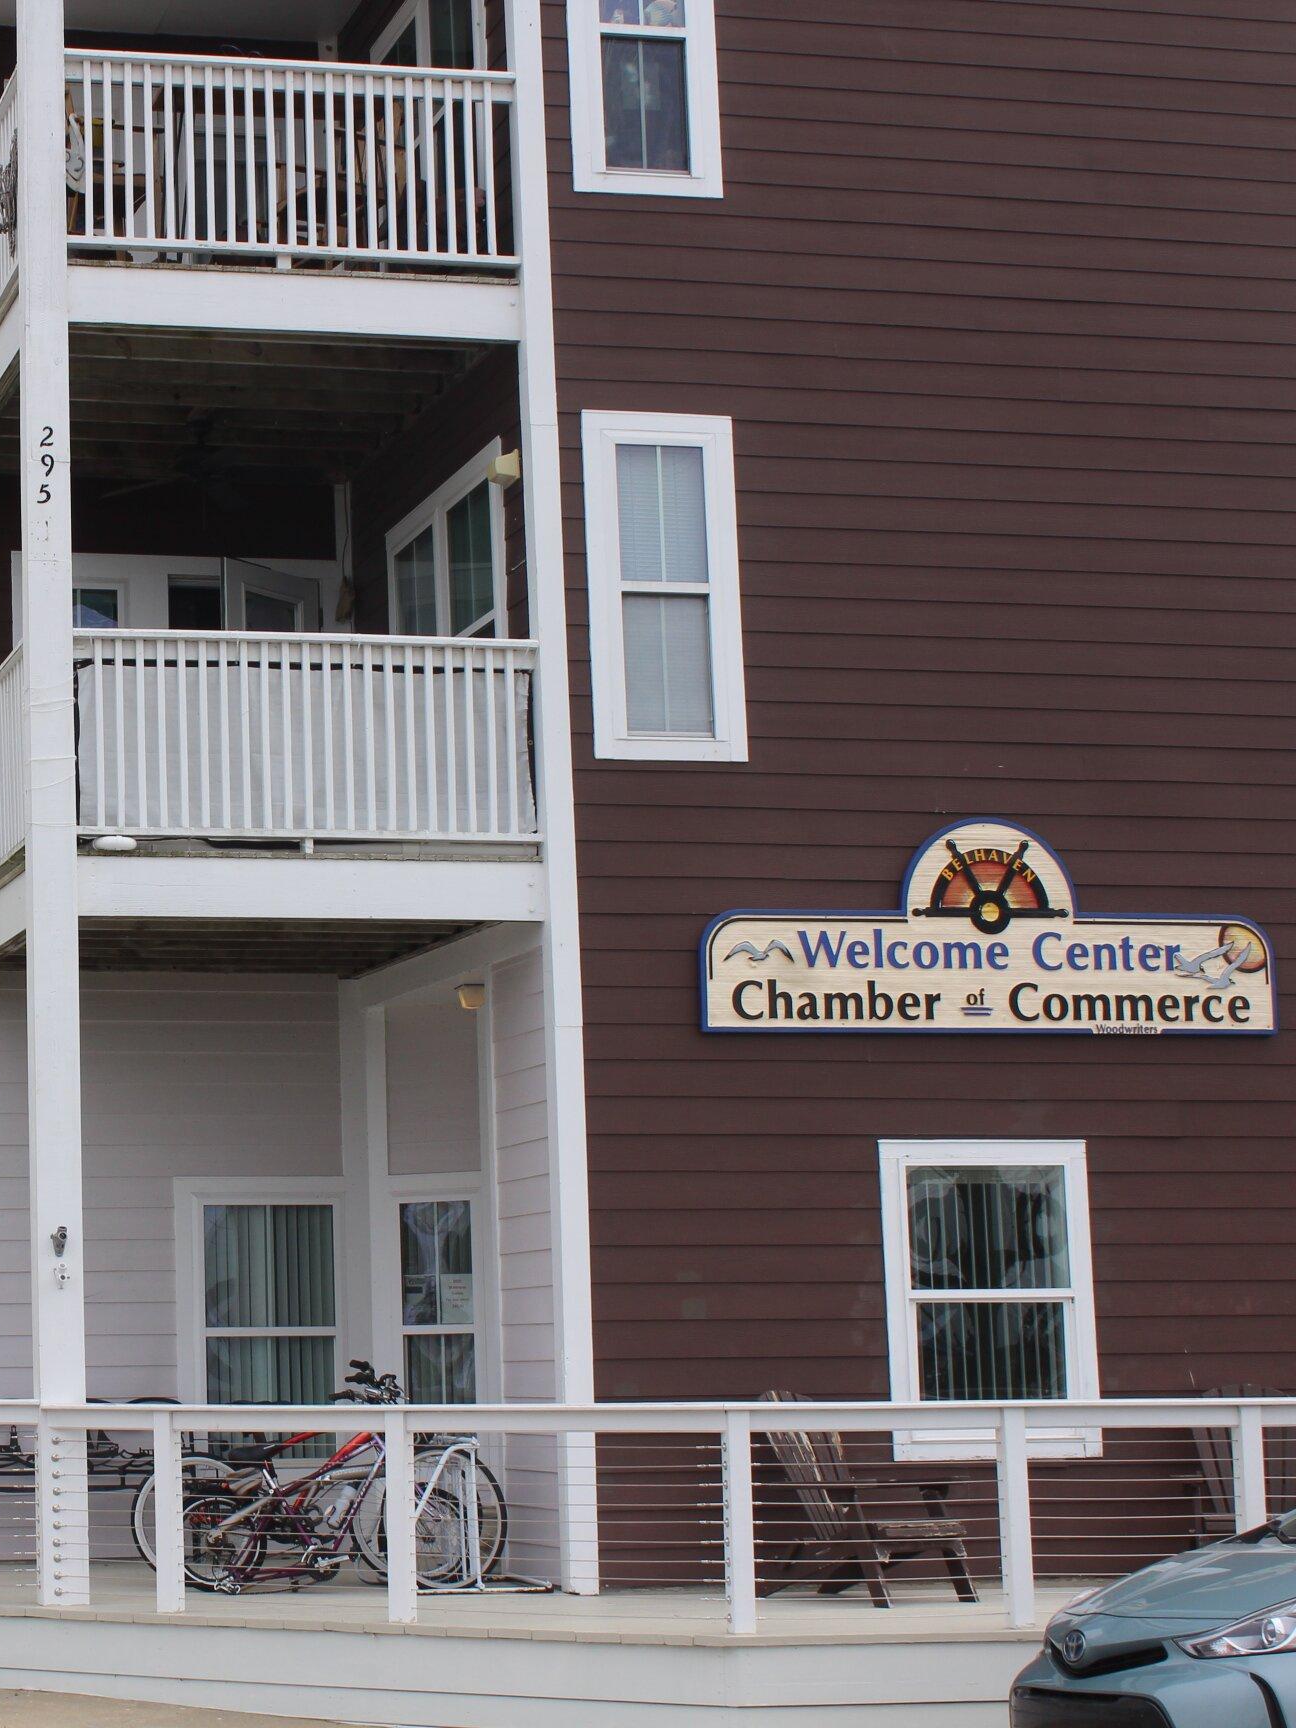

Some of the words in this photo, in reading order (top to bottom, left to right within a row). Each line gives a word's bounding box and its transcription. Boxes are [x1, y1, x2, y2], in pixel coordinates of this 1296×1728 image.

[37, 426, 55, 504] 295
[942, 849, 1036, 883] BELHAVEN
[797, 928, 1010, 970] Welcome
[1032, 931, 1181, 972] Center
[732, 978, 942, 1021] Chamber
[966, 988, 985, 1006] of
[1008, 982, 1251, 1023] Commerce
[1096, 1024, 1158, 1035] Woodwriters
